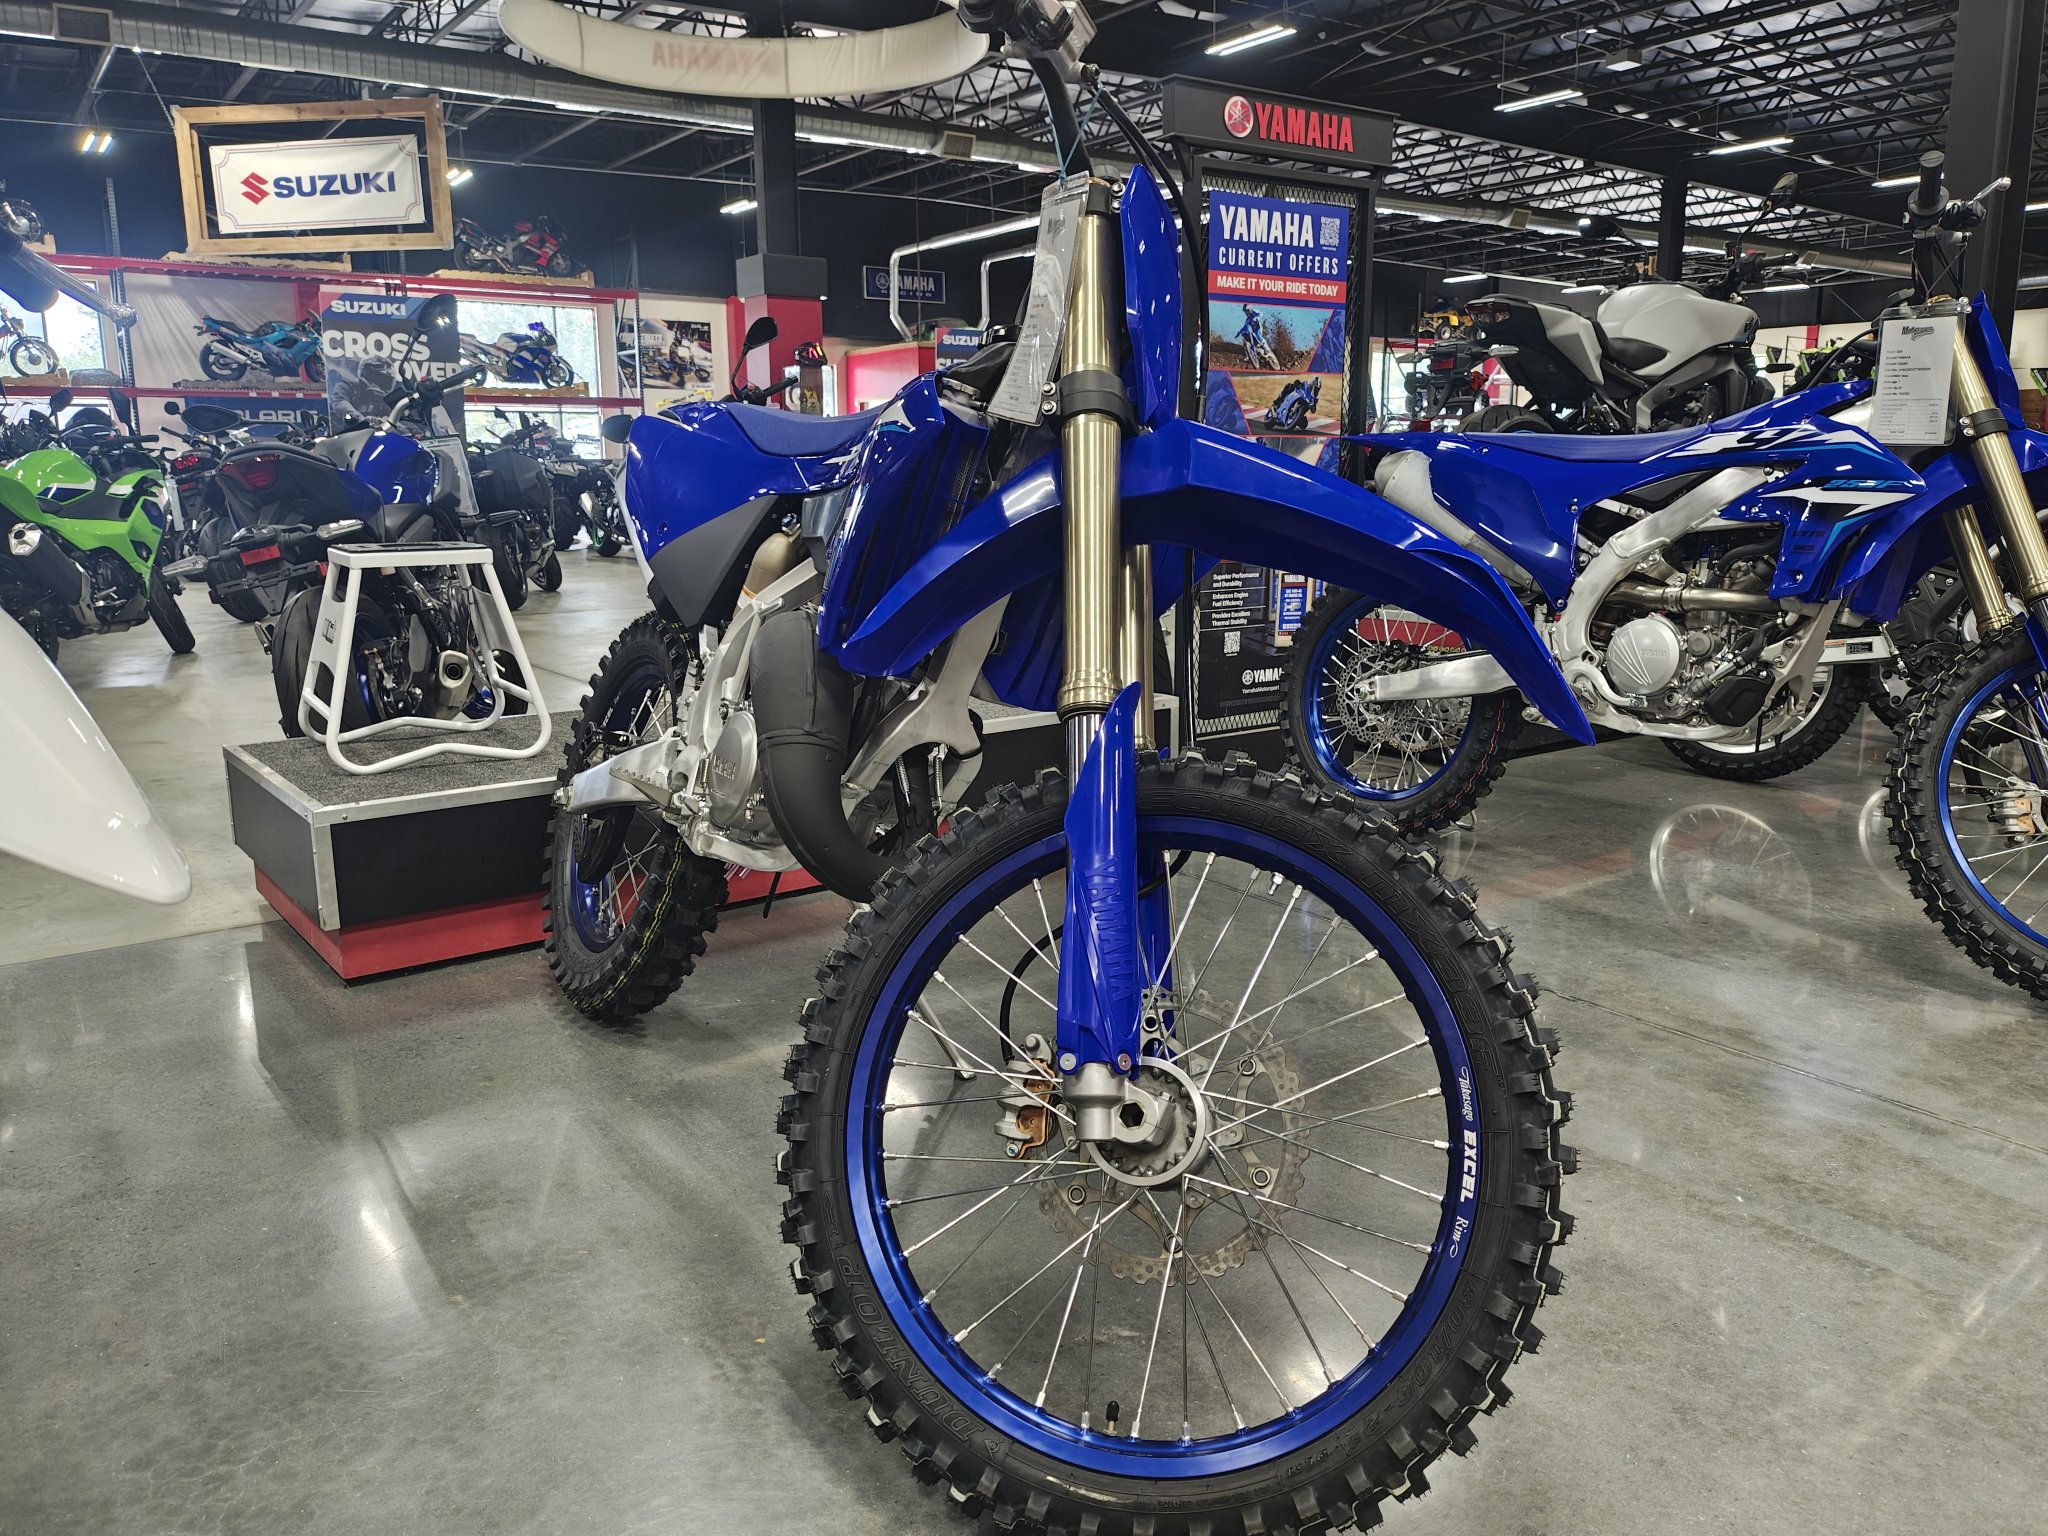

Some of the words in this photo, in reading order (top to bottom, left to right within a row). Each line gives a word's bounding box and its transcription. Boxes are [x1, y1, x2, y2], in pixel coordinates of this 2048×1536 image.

[1255, 101, 1354, 152] YAMAHA
[273, 170, 396, 198] SUZUKI
[1219, 204, 1314, 248] YAMAHA
[1218, 246, 1283, 271] CURRENT
[1289, 253, 1339, 275] OFFERS
[897, 275, 935, 292] AMAHA
[1217, 275, 1246, 289] MAKE
[1247, 277, 1257, 290] IT
[1258, 279, 1285, 293] YOUR
[1286, 280, 1307, 294] RIDE
[1308, 282, 1339, 297] TODAY
[330, 300, 406, 316] SUZUKI
[322, 329, 431, 361] CROSS
[1253, 667, 1284, 683] YAMA
[1083, 857, 1134, 1001] YAMAHA
[1458, 1066, 1474, 1122] Takasago
[1460, 1129, 1477, 1202] EXCEL
[1449, 1215, 1469, 1258] Rim
[837, 1256, 985, 1442] DUNLOP
